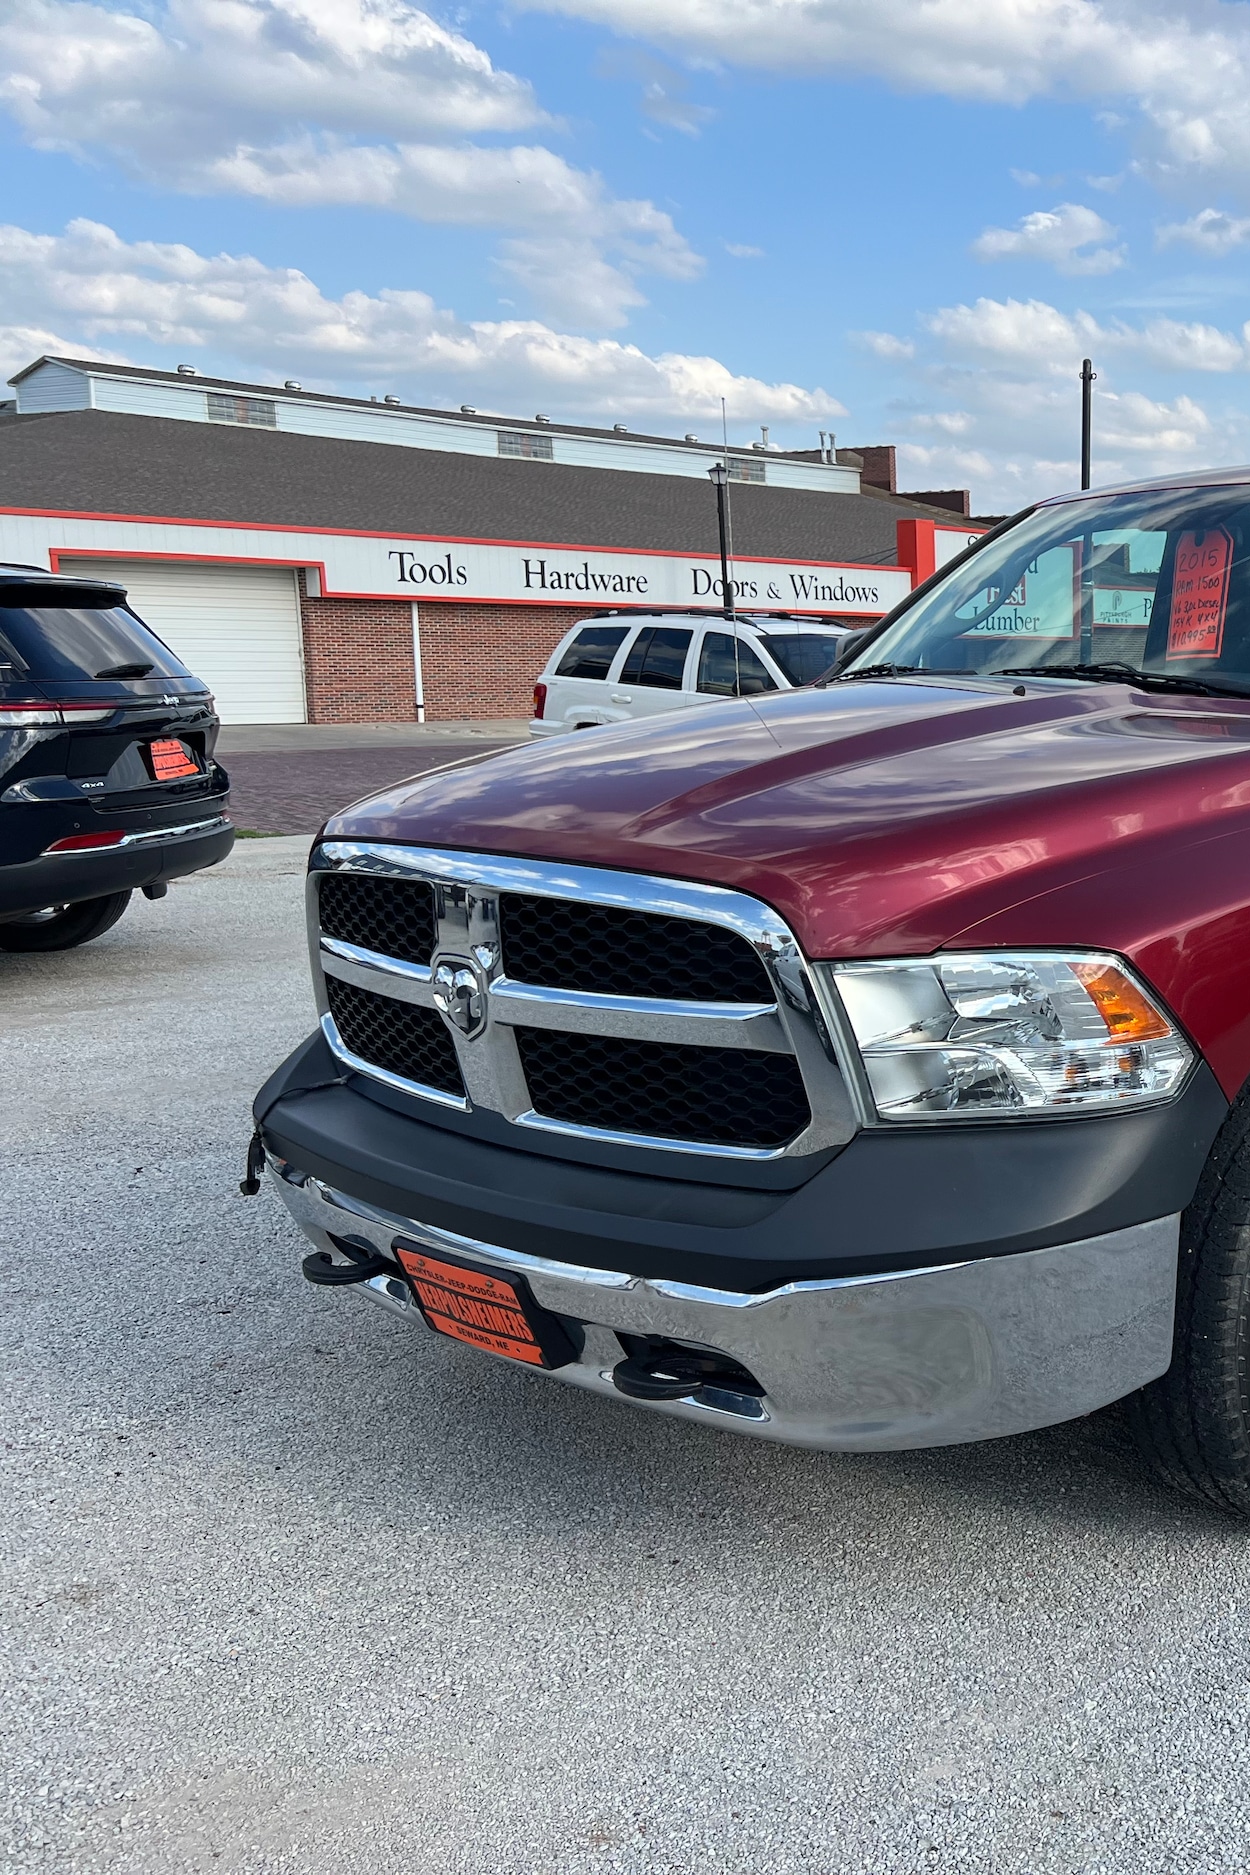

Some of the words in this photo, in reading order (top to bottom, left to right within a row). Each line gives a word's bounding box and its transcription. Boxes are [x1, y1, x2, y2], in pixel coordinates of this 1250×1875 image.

[388, 550, 468, 586] Tools
[1178, 548, 1218, 573] 2015
[521, 558, 649, 594] Hardware
[766, 581, 782, 600] &
[789, 573, 879, 604] Windows
[1175, 579, 1194, 598] RAM
[1197, 575, 1220, 591] 1500
[973, 606, 1040, 632] Lumber
[496, 1340, 510, 1351] NE
